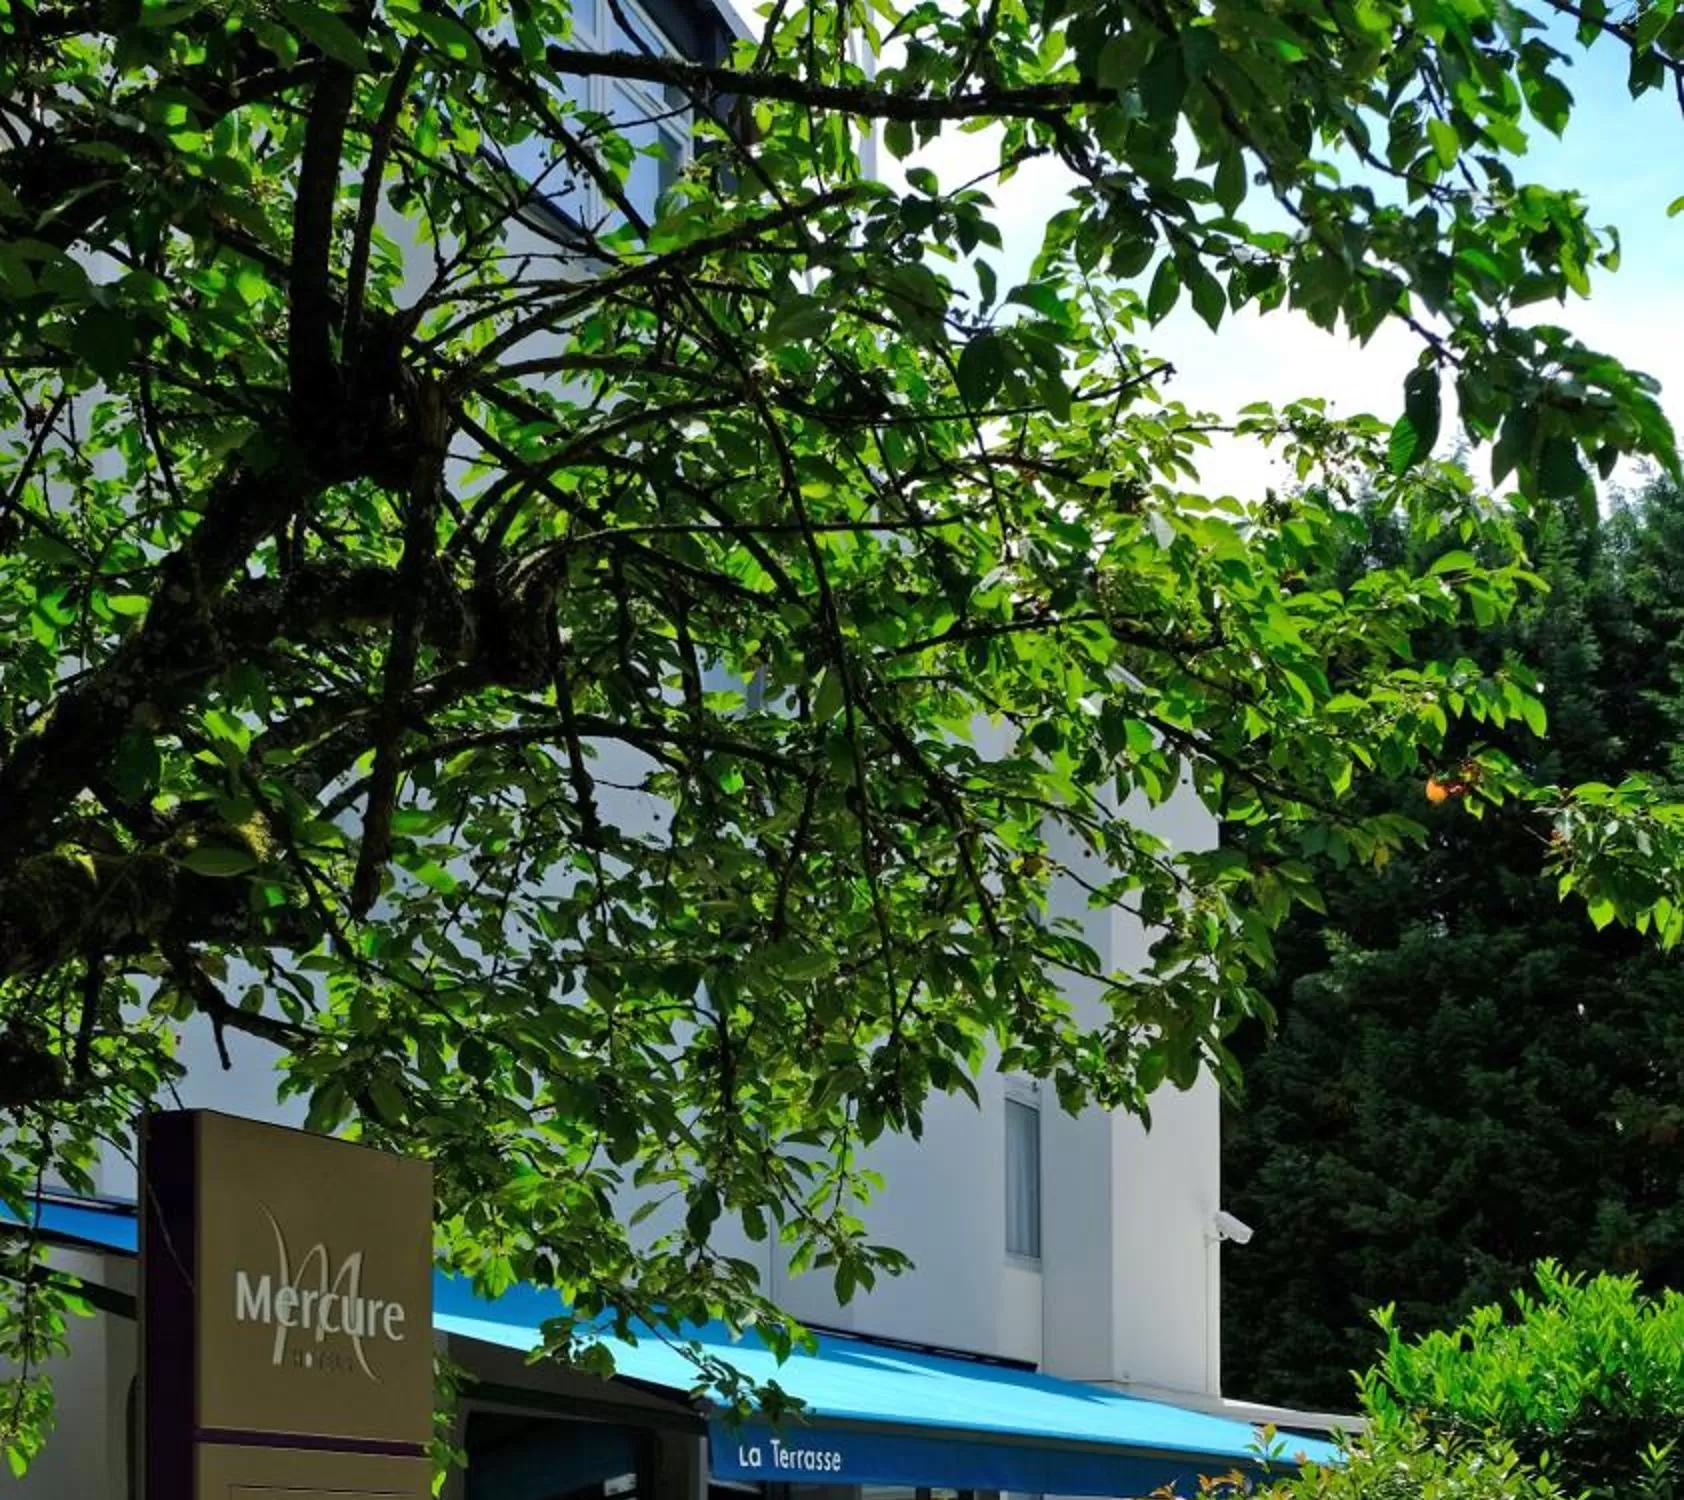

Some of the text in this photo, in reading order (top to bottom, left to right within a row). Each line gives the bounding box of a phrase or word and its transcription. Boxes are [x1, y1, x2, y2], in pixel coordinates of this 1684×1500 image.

[235, 1270, 406, 1342] Mercure
[738, 1439, 841, 1472] La Terrasse
